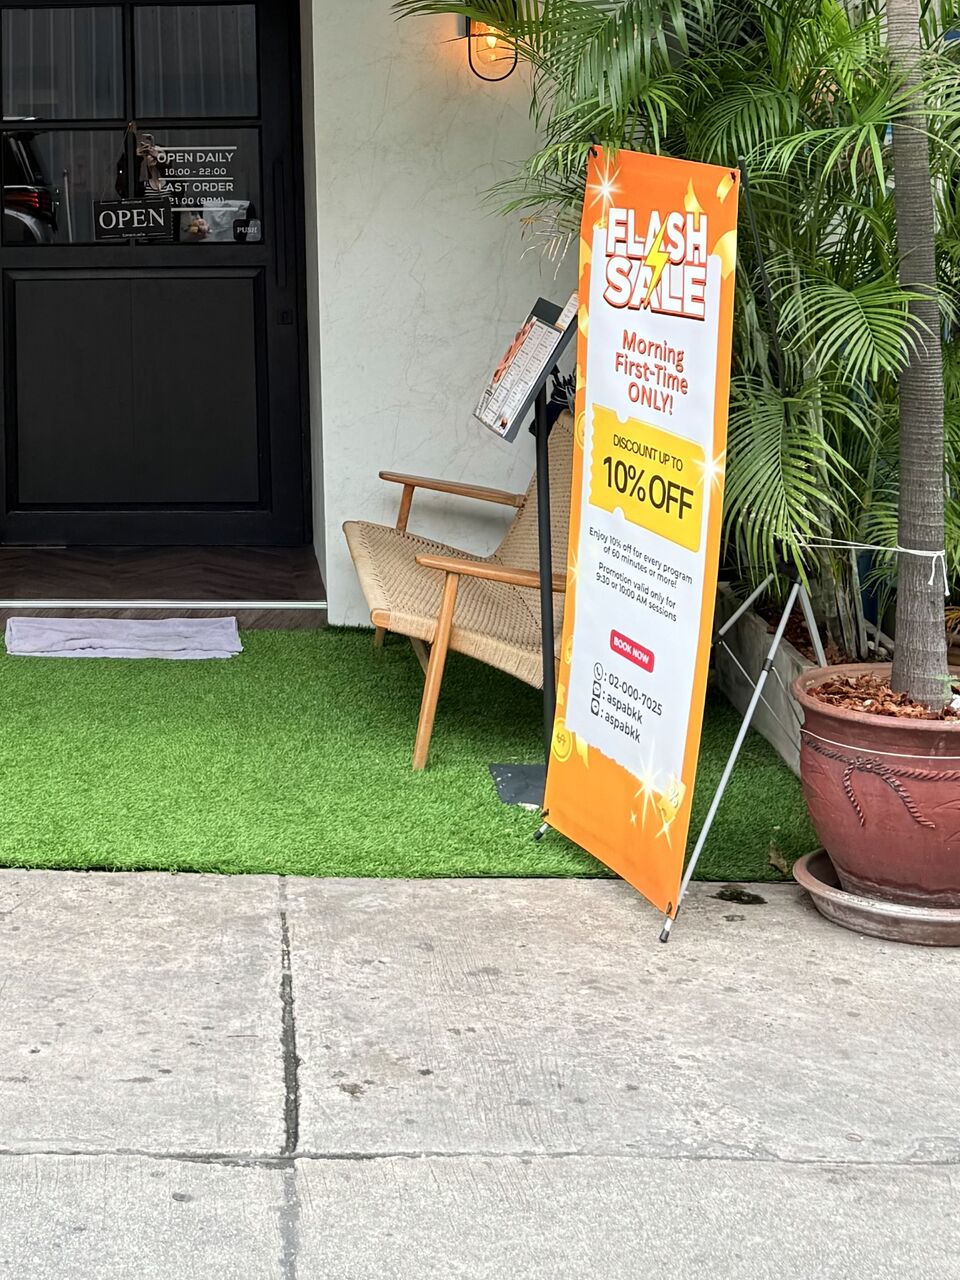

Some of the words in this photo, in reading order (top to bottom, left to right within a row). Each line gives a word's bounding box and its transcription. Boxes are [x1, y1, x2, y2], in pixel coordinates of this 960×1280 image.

[156, 152, 193, 163] OPEN
[196, 152, 234, 163] DAILY
[192, 182, 234, 192] ORDER
[99, 208, 165, 229] OPEN
[606, 207, 708, 267] FLASH
[603, 256, 707, 320] SALE
[622, 329, 684, 373] Morning
[615, 352, 689, 395] First-Time
[628, 382, 674, 415] ONLY!
[613, 434, 658, 461] DISCOUNT
[658, 449, 671, 465] UP
[671, 456, 683, 471] TO
[603, 456, 646, 502] 10%
[648, 474, 694, 519] OFF
[589, 526, 609, 544] Enjoy
[632, 547, 642, 559] for
[643, 554, 662, 570] every
[662, 563, 693, 584] program
[603, 545, 611, 554] of
[611, 548, 620, 559] 60
[621, 554, 648, 574] minutes
[656, 572, 677, 589] more!
[598, 561, 632, 586] Promotion
[633, 580, 650, 595] valid
[650, 590, 665, 604] only
[665, 596, 676, 609] for
[636, 594, 648, 606] AM
[648, 601, 677, 622] sessions
[613, 635, 632, 655] BOOK
[632, 646, 650, 665] NOW
